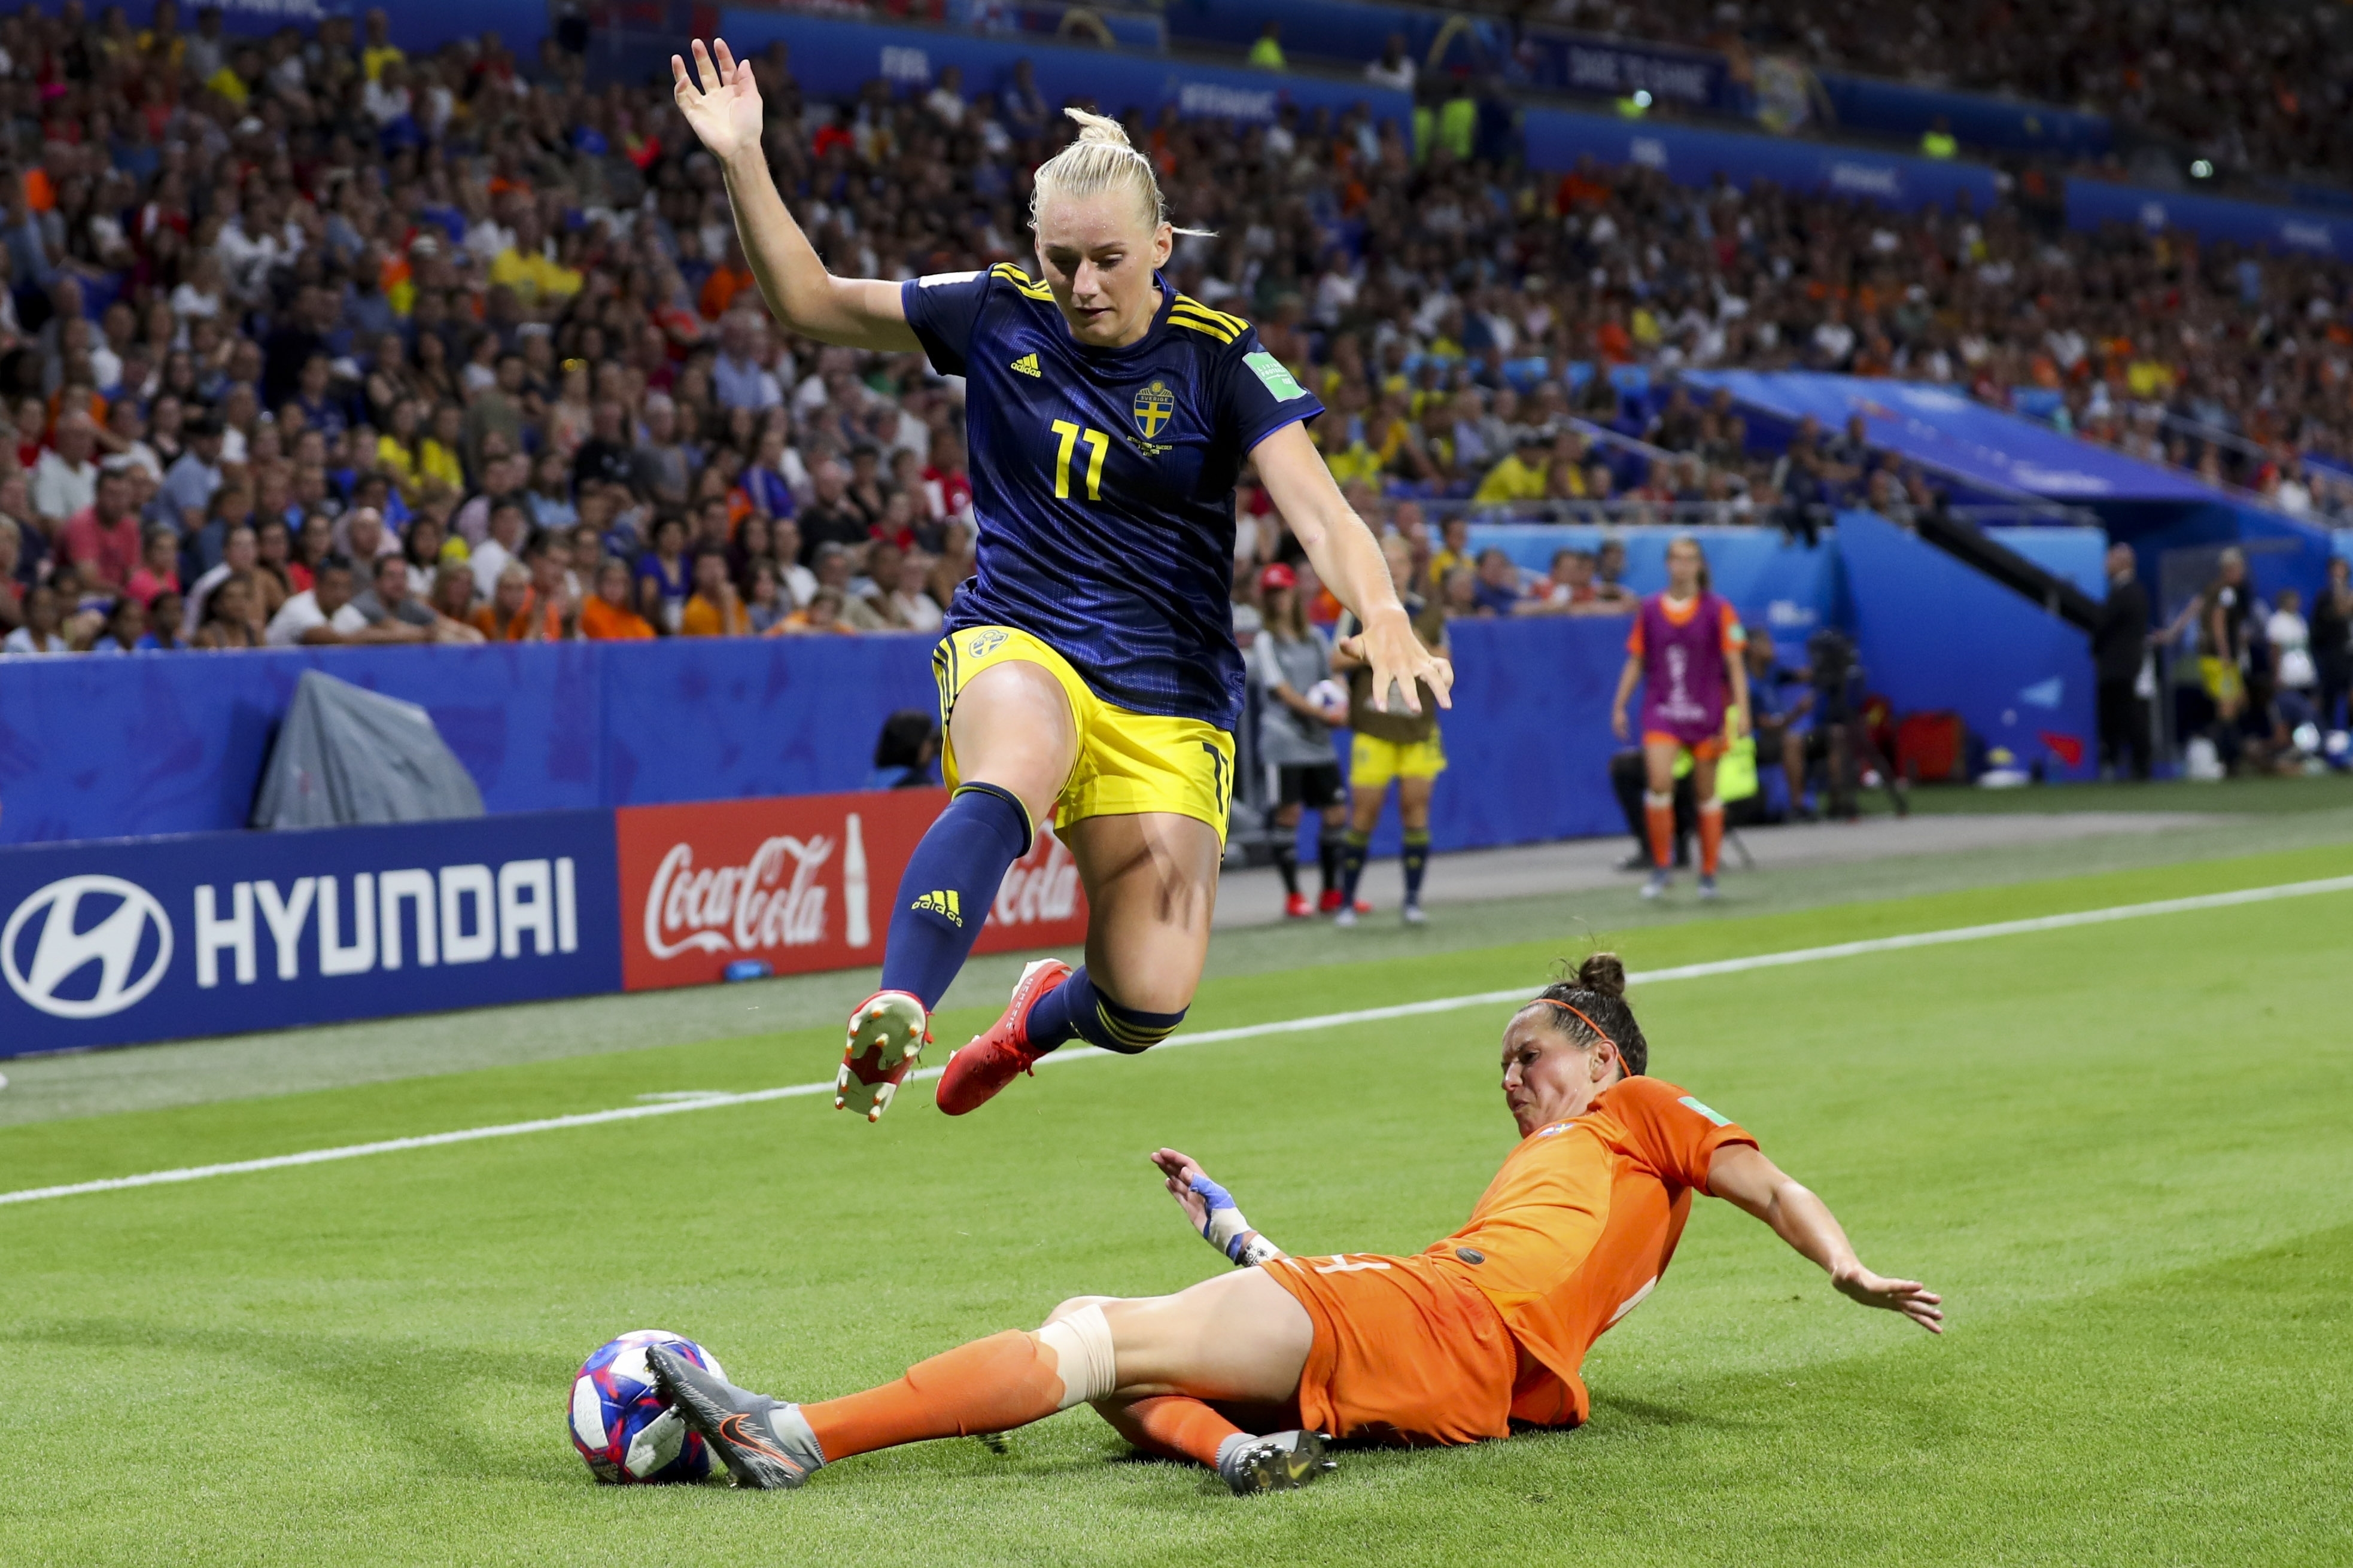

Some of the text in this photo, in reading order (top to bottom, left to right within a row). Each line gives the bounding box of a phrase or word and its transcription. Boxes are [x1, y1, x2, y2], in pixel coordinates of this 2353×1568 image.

[1011, 362, 1041, 378] adidas
[1051, 419, 1109, 501] 11
[194, 857, 577, 988] HYUNDAI
[911, 900, 962, 927] adidas
